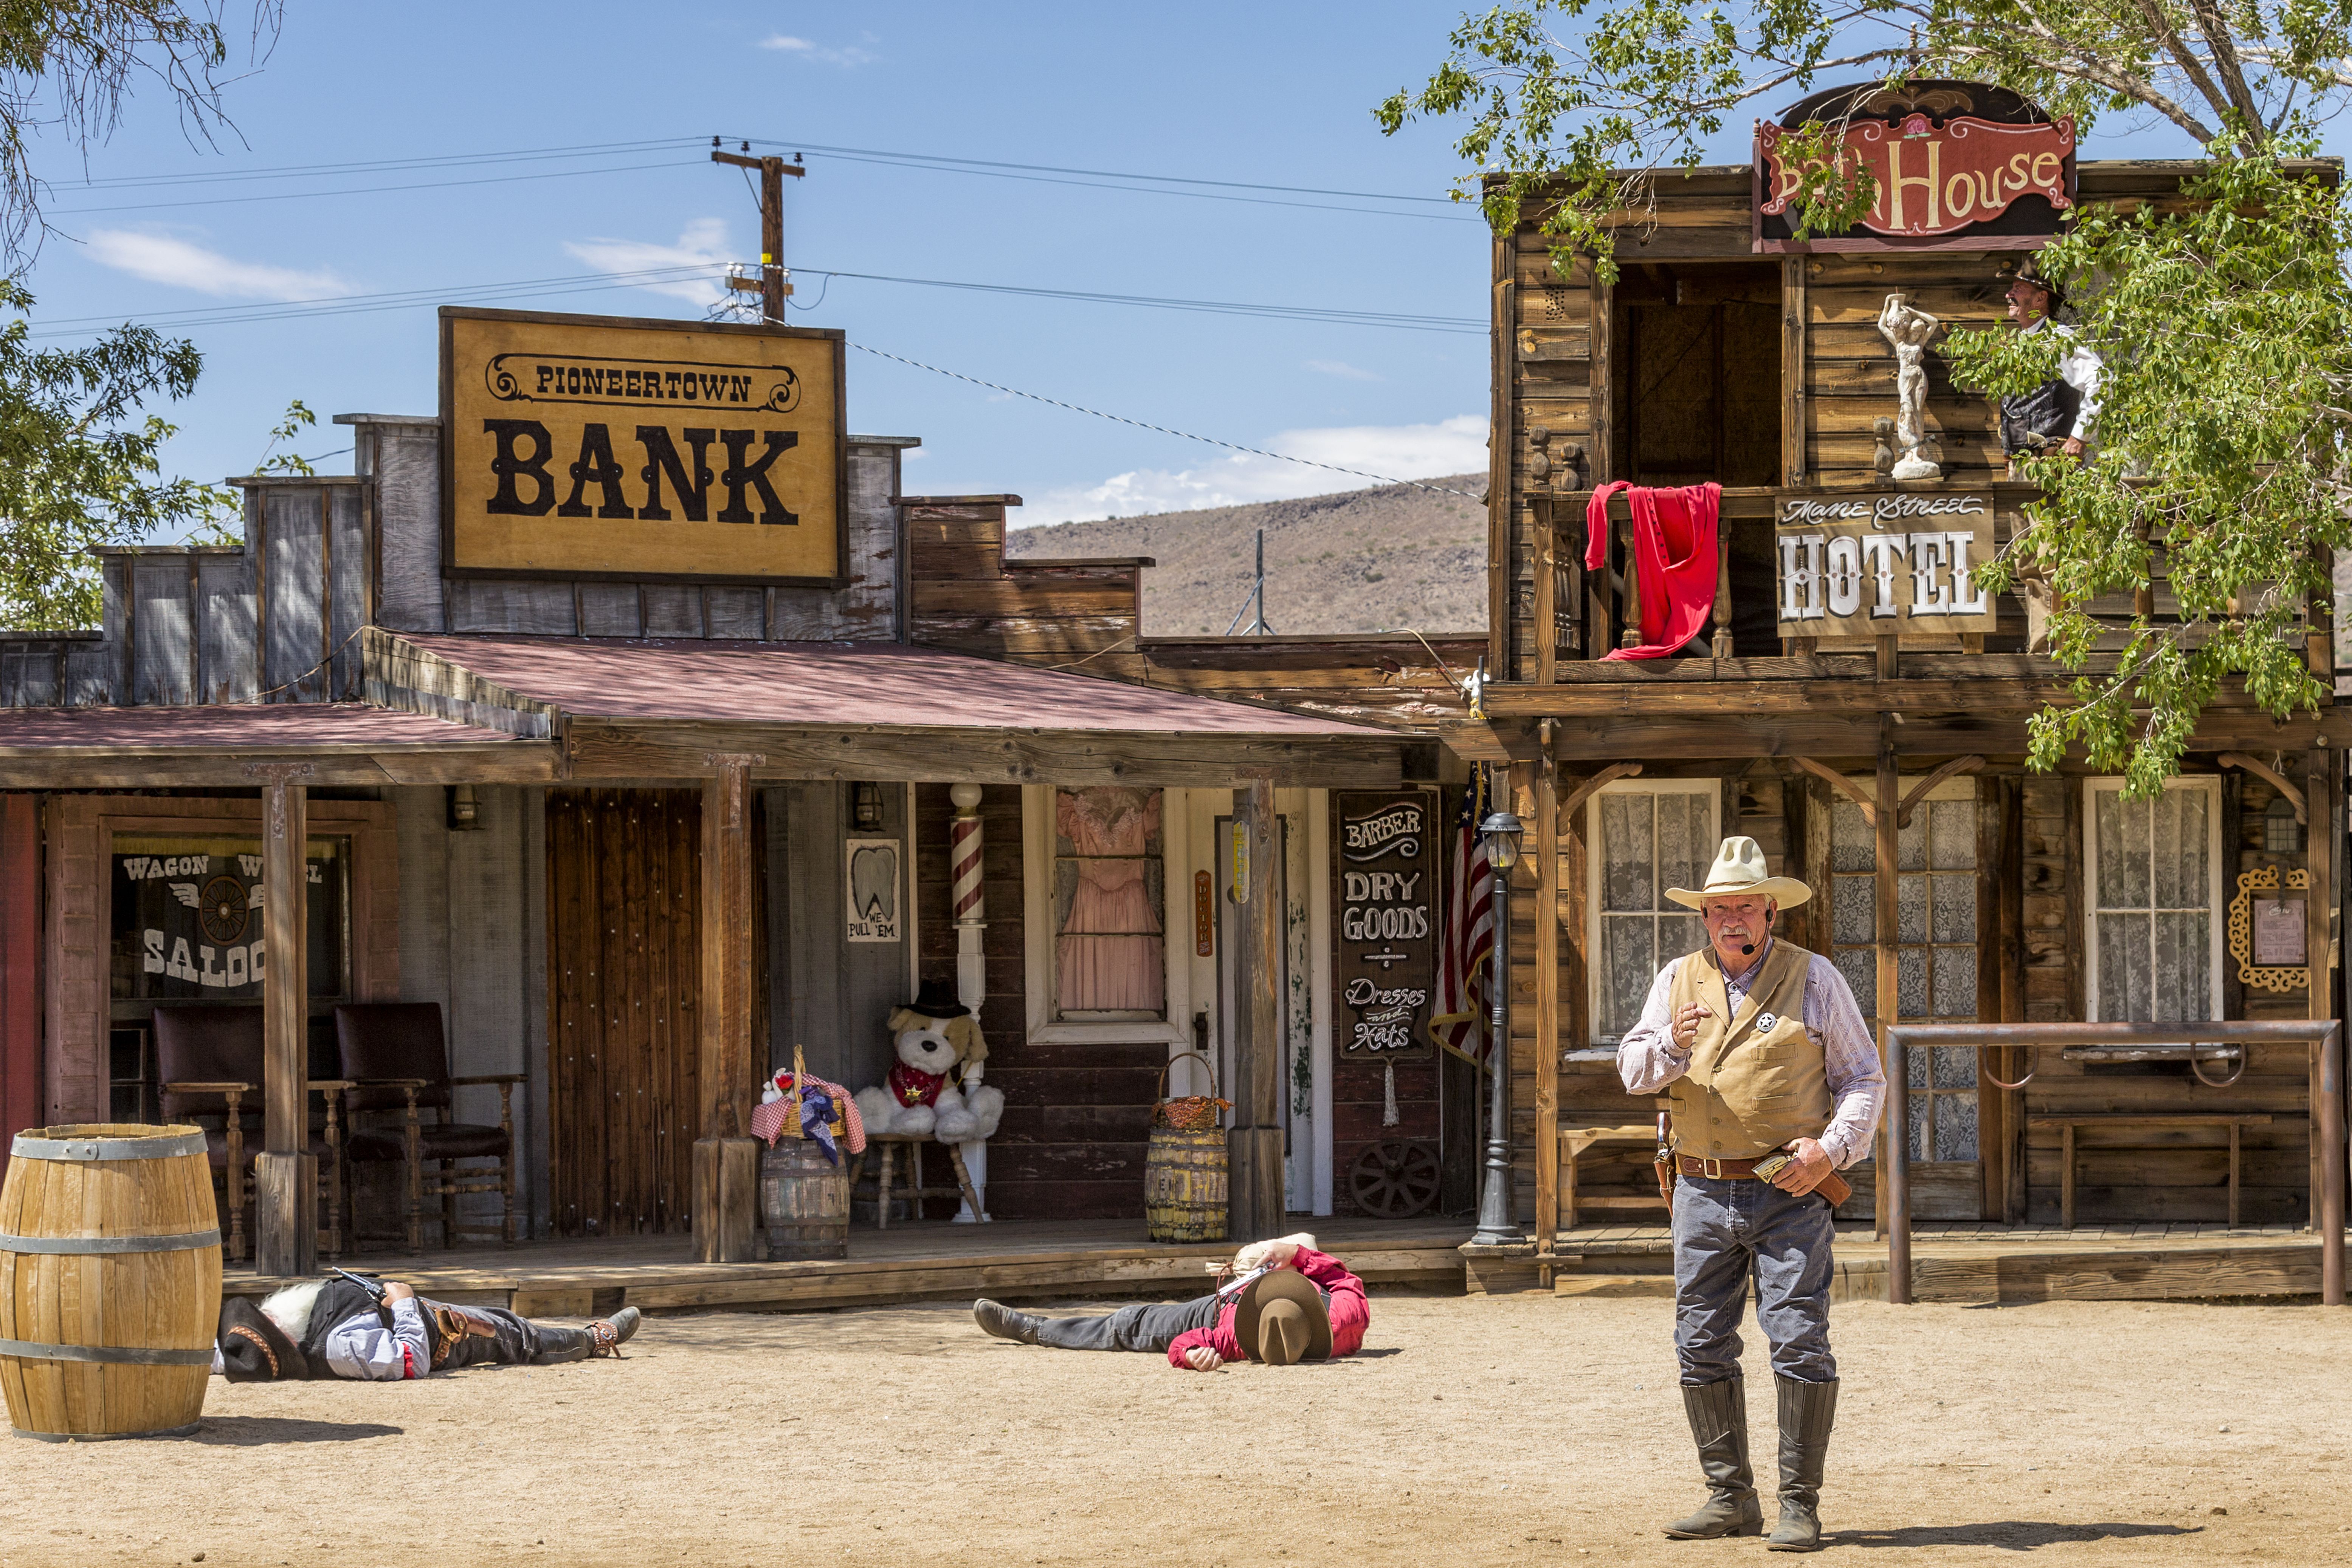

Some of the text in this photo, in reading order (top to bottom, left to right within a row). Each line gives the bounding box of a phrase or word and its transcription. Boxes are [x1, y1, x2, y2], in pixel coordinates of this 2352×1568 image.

[1887, 141, 2059, 230] House
[536, 365, 752, 402] PIONEERTOWN
[483, 418, 798, 526] BANK
[1779, 531, 1988, 621] HOTEL
[1345, 810, 1421, 848] BARBER
[123, 855, 209, 880] WAGON
[1344, 872, 1420, 901] DRY
[848, 923, 871, 937] PULL
[870, 912, 882, 923] WE
[1199, 885, 1208, 941] DOCTOR
[1343, 906, 1428, 940] GOODS
[144, 929, 265, 988] SALOO
[1345, 978, 1426, 1007] Dresses
[1367, 1007, 1409, 1022] and
[1349, 1023, 1409, 1050] Hats
